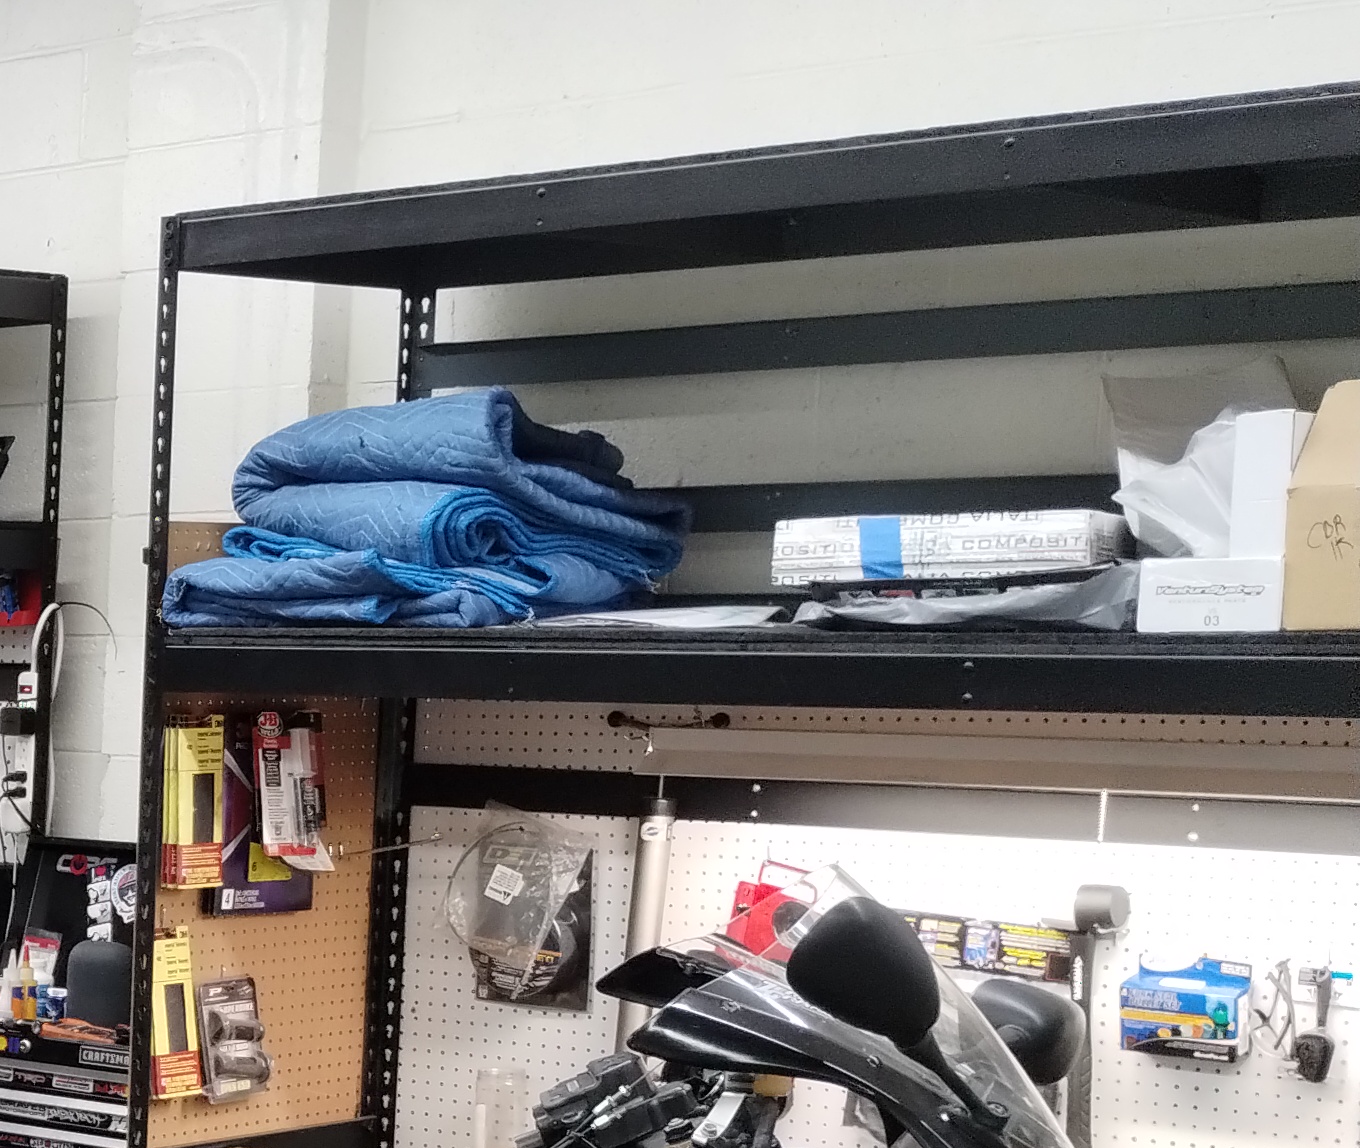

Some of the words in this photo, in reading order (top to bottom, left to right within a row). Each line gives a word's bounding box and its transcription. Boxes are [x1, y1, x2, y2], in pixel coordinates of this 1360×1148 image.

[1204, 615, 1220, 627] 03
[260, 713, 280, 727] J-B
[82, 1050, 129, 1066] CRAFTSMA
